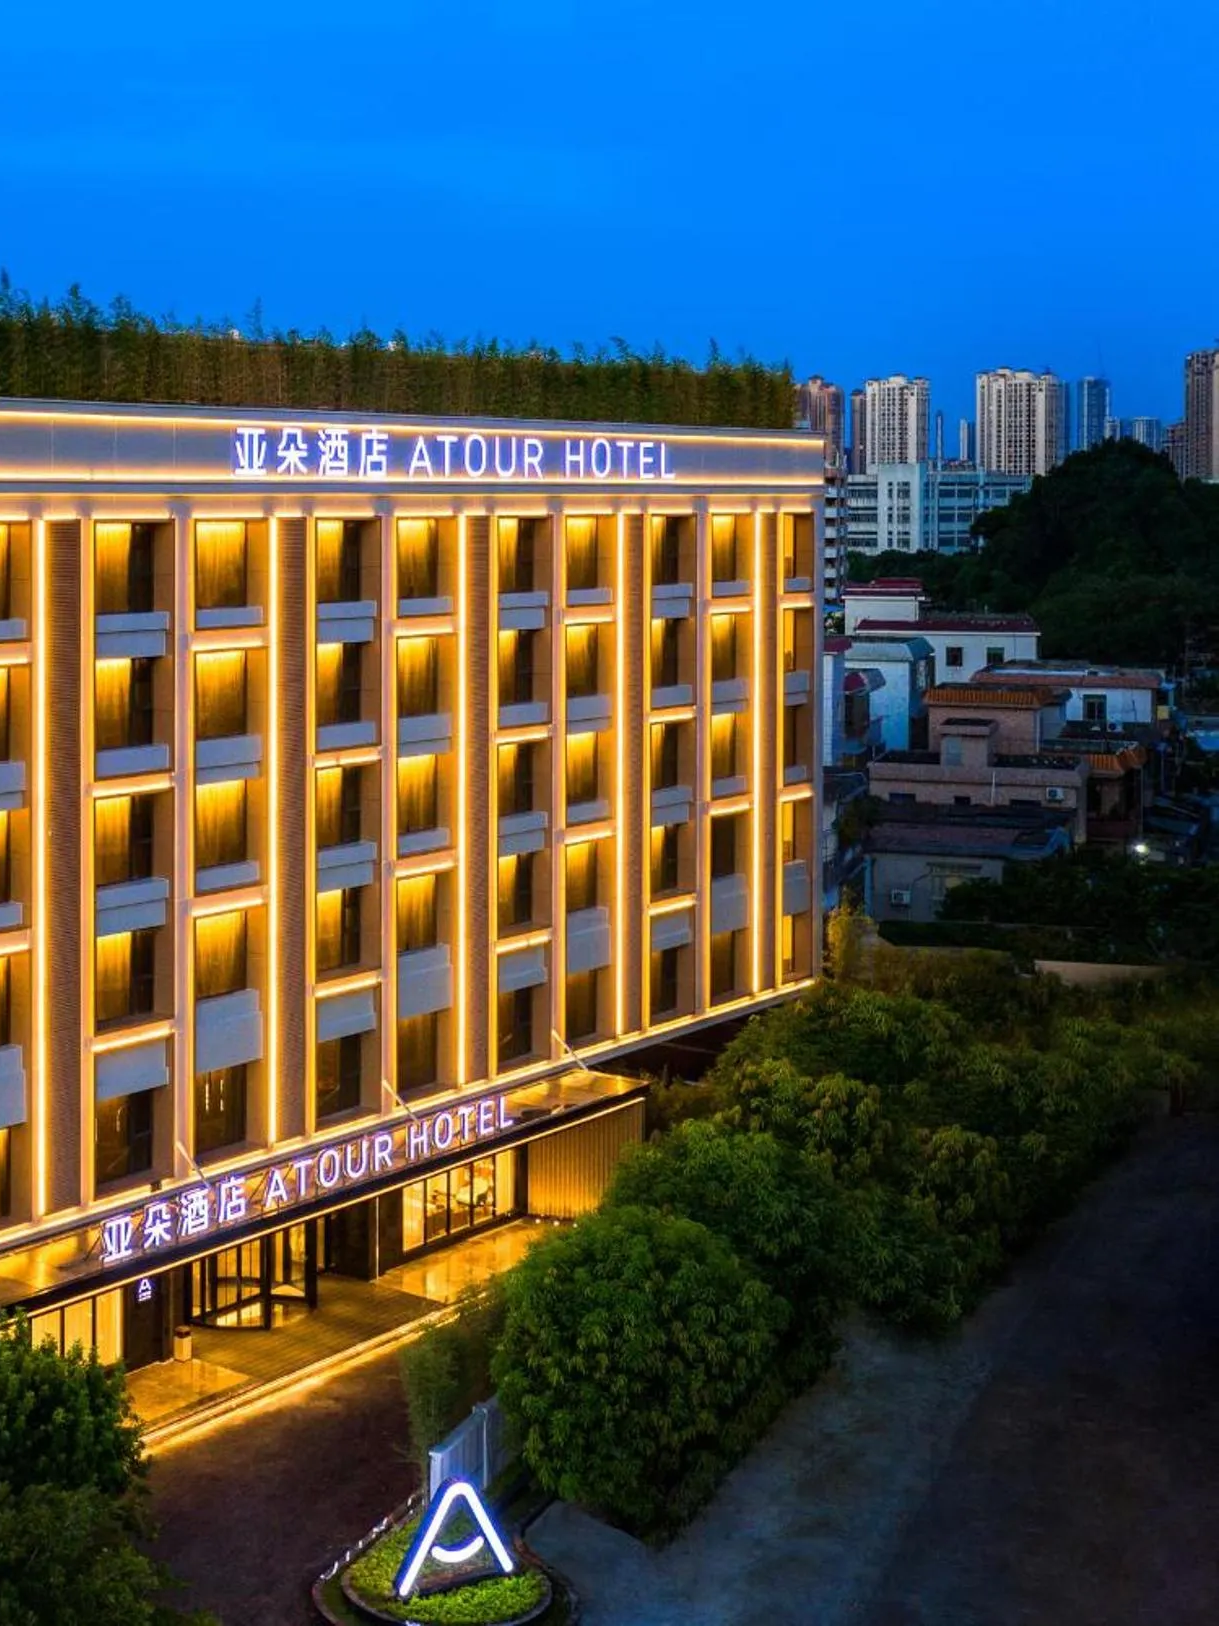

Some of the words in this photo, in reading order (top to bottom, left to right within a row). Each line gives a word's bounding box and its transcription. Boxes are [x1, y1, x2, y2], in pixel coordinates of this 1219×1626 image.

[233, 427, 387, 478] 亚朵酒店
[408, 434, 544, 479] ATOUR
[564, 438, 675, 480] HOTEL
[101, 1177, 247, 1262] 亚朵酒店
[265, 1134, 393, 1209] ATOUR
[406, 1096, 514, 1160] HOTEL
